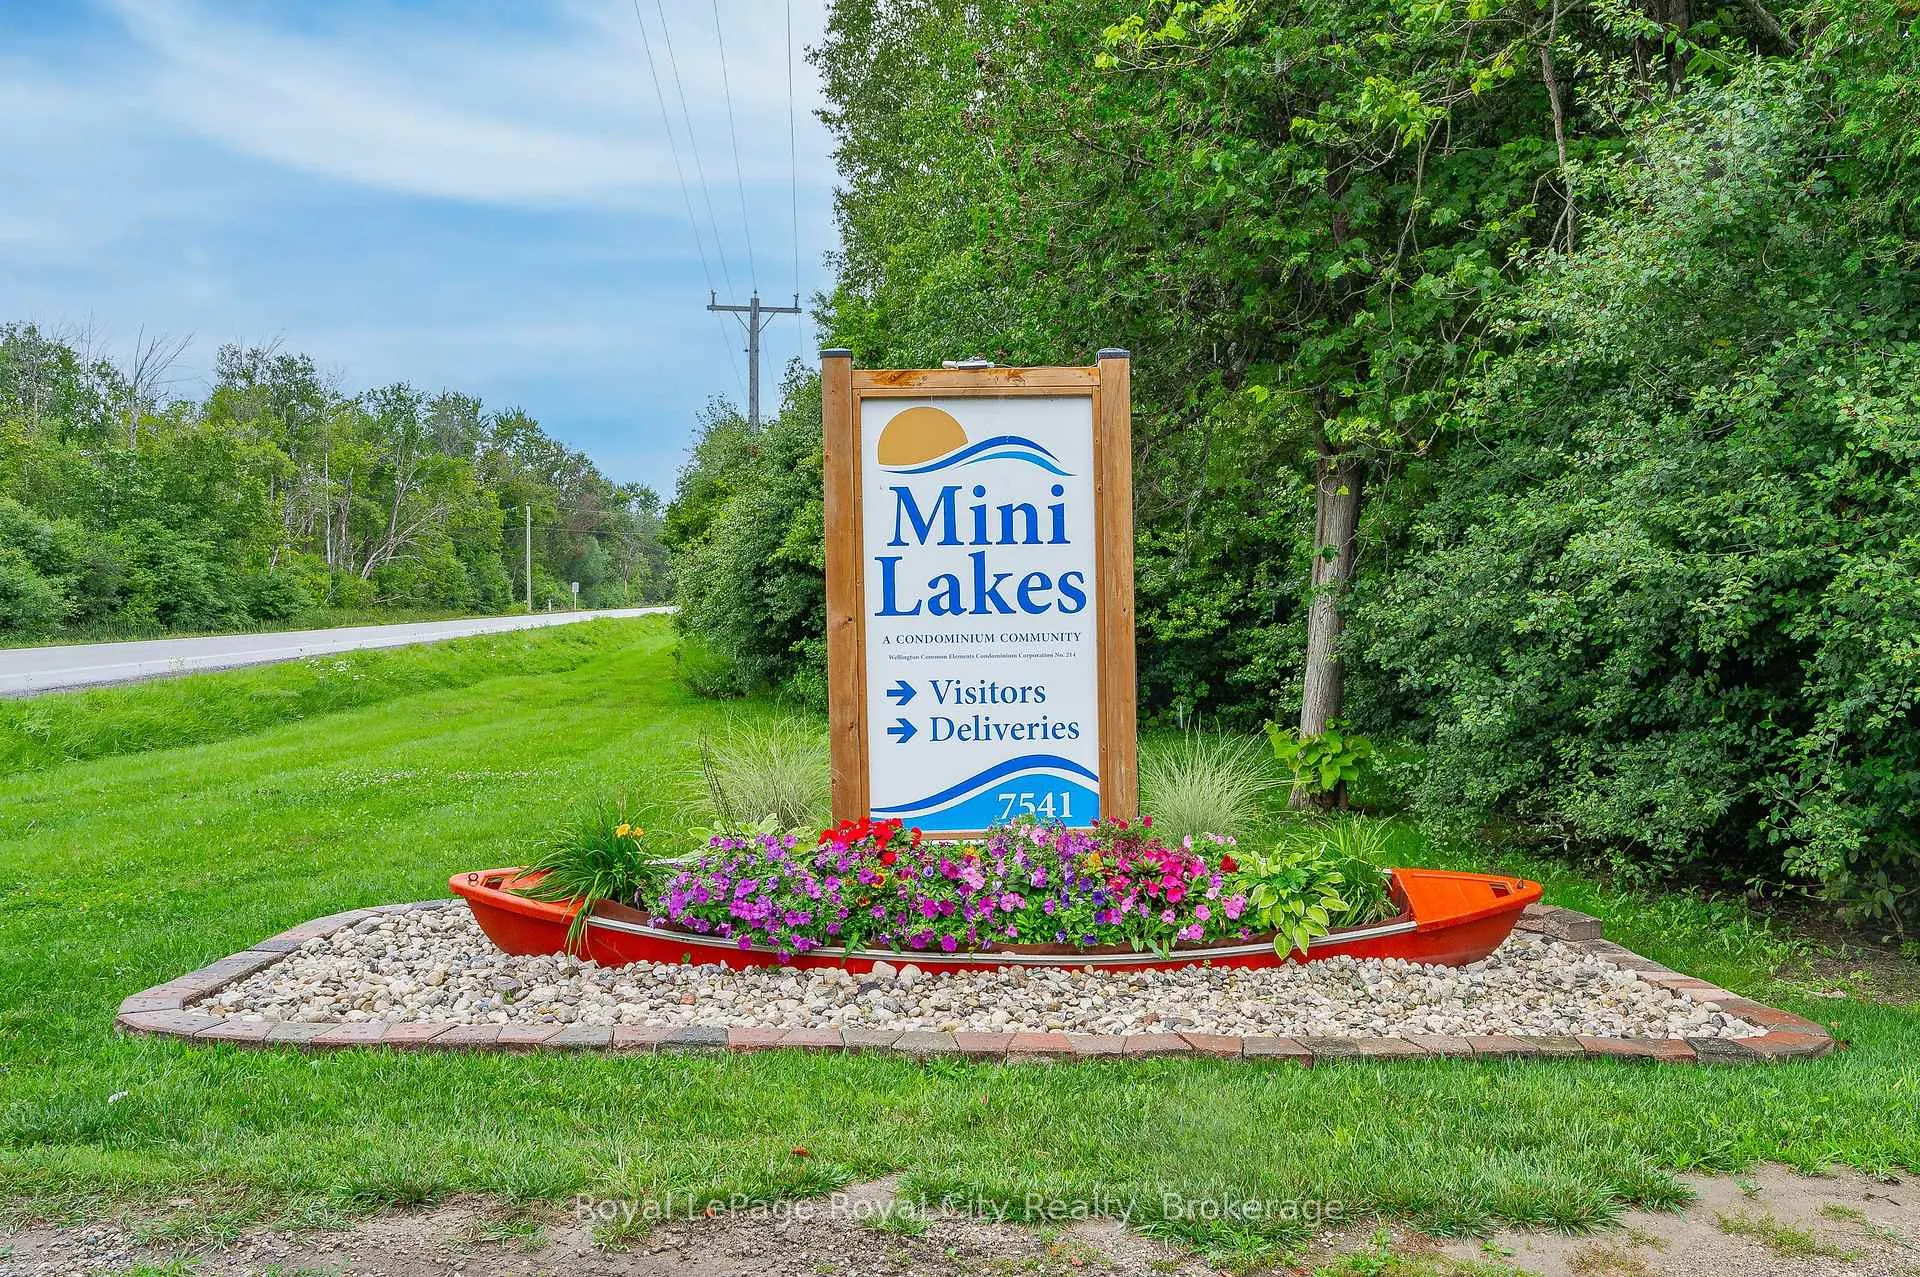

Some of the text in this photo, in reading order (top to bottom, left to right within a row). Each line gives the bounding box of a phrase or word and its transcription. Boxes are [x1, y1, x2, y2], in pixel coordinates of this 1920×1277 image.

[887, 484, 1071, 547] Mini
[874, 550, 1087, 617] Lakes
[882, 632, 1081, 645] A CONDOMINIUM COMMUNITY
[1018, 652, 1054, 661] Corporation
[929, 679, 1046, 705] Visitors
[929, 714, 1080, 742] Deliveries
[998, 791, 1073, 820] 7541
